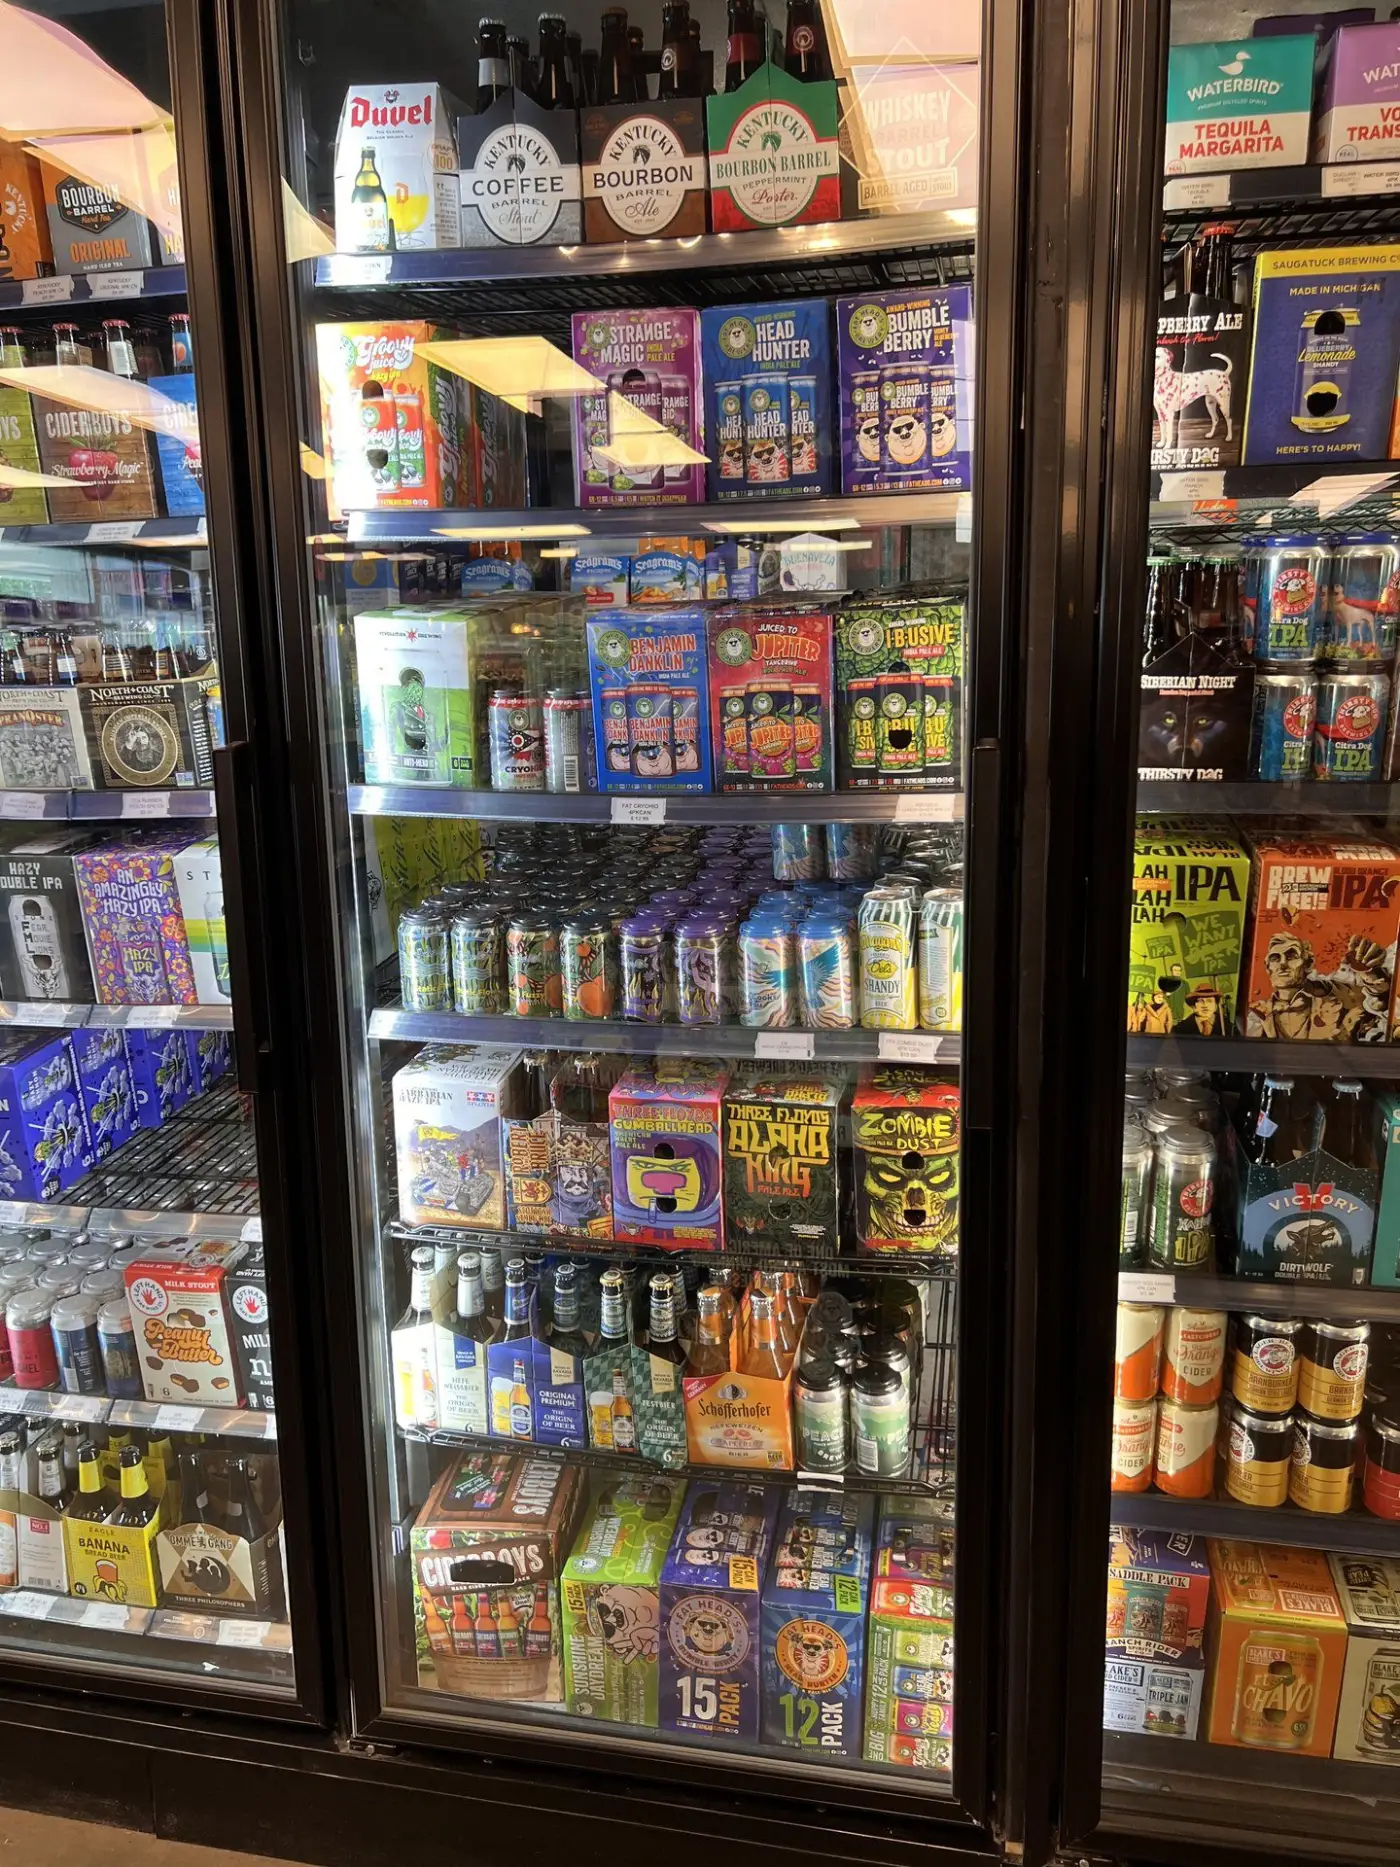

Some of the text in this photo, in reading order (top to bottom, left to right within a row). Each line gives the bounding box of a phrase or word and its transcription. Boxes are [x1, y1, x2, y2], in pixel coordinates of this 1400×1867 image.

[1187, 78, 1281, 102] WATERBIRD
[350, 96, 432, 128] Duvel
[737, 111, 808, 150] KENTUCKY
[1195, 119, 1270, 140] TEQUILA
[609, 124, 677, 161] KENTUCKY
[1179, 136, 1284, 159] MARGARITA
[484, 134, 551, 170] KENTUCKY
[716, 150, 831, 179] BOURBON BARREL
[593, 165, 693, 189] BOURBON
[742, 176, 807, 191] PEPPERMINT
[472, 176, 564, 197] COFFEE
[615, 188, 674, 200] BARREL
[61, 183, 121, 208] BOURBON
[491, 198, 549, 208] BARREL
[752, 187, 795, 205] Porter
[73, 204, 115, 216] BARREL
[624, 196, 660, 218] Ale
[499, 209, 544, 225] Stout
[70, 238, 131, 263] ORIGINAL
[1273, 258, 1335, 270] SAUGATUCK
[1338, 255, 1387, 267] BREWING
[1289, 287, 1318, 296] MADE
[1320, 286, 1330, 294] IN
[887, 306, 950, 333] BUMBLE
[609, 321, 672, 344] STRANGE
[756, 320, 795, 342] HEAD
[883, 329, 933, 353] BERRY
[1306, 344, 1350, 353] BLUEBERRY
[355, 335, 416, 371] Groovy
[600, 344, 644, 363] MAGIC
[663, 353, 675, 361] ALE
[752, 340, 810, 362] HUNTER
[1298, 348, 1357, 363] Lemonade
[1312, 361, 1339, 369] SHANDY
[896, 383, 929, 397] BUMBLE
[890, 396, 917, 408] BERRY
[45, 410, 132, 438] CIDERBOYS
[754, 410, 780, 426] HEAD
[747, 422, 786, 439] HUNTER
[1276, 443, 1361, 455] HERE'S TO HAPPY!
[51, 460, 143, 479] Strawberry Magic
[574, 556, 623, 572] Seagram's
[634, 560, 683, 573] Seagram's
[758, 624, 798, 634] JUICED TO
[1292, 616, 1309, 626] Dog
[1269, 622, 1308, 648] IPA
[629, 634, 696, 655] BENJAMIN
[751, 634, 821, 662] JUPITER
[628, 652, 684, 672] DANKLIN
[1140, 675, 1237, 689] SIBERIAN NIGHT
[89, 685, 175, 701] NORTH COAST
[629, 717, 672, 729] BENJAMIN
[634, 729, 670, 741] DANKLIN
[1335, 741, 1372, 750] Citra Dog
[1333, 750, 1374, 771] IPA
[1138, 768, 1223, 781] THIRSTY DOG
[9, 862, 41, 875] HAZY
[117, 869, 134, 883] AN
[1269, 865, 1332, 887] BREW
[43, 877, 63, 890] IPA
[1174, 864, 1241, 902] IPA
[1330, 874, 1390, 908] IPA
[103, 898, 161, 917] HAZY IPA
[1192, 913, 1219, 930] WE
[1184, 925, 1236, 948] WANT
[123, 948, 157, 962] HAZY
[1151, 946, 1172, 957] IPA
[133, 961, 153, 973] IPA
[1203, 960, 1227, 973] IPA
[865, 982, 900, 994] SHANDY
[612, 1105, 713, 1123] THREE FLOYDS
[726, 1103, 829, 1125] THREE FLOYDS
[613, 1119, 714, 1134] GUMBALLHEAD
[858, 1112, 953, 1138] ZOMBIE
[728, 1120, 830, 1158] ALPHA
[897, 1137, 941, 1151] DUST
[757, 1184, 799, 1197] PALE ALE
[1268, 1193, 1359, 1214] VICTORY
[1279, 1262, 1331, 1272] DIRTWOLF
[134, 1282, 163, 1298] LEFT HAND
[144, 1318, 210, 1350] Peanut
[158, 1340, 223, 1365] Butter
[1183, 1367, 1212, 1377] CIDER
[451, 1377, 470, 1385] HEFE
[539, 1390, 575, 1400] ORIGINAL
[540, 1397, 575, 1408] PREMIUM
[447, 1399, 477, 1408] ORIGIN
[699, 1398, 771, 1418] Schöfferhofer
[542, 1420, 575, 1430] OF BEER
[544, 1414, 573, 1424] ORIGIN
[710, 1422, 763, 1432] HEFEWEIZEN
[647, 1424, 676, 1433] ORIGIN
[657, 1432, 679, 1440] BEER
[1118, 1459, 1145, 1468] CIDER
[88, 1527, 115, 1536] EAGLE
[78, 1537, 130, 1555] BANANA
[84, 1550, 126, 1560] BREAD BEER
[1109, 1568, 1189, 1588] SADDLE PACK
[175, 1595, 245, 1608] THREE PHILOSOPHERS
[566, 1586, 584, 1613] 15 CAN
[782, 1624, 842, 1650] FAT HEAD'S
[1145, 1642, 1178, 1656] RIDER
[1249, 1649, 1281, 1659] BLAKE'S
[570, 1634, 591, 1696] SUNSHINE
[587, 1636, 606, 1700] DAYDREAM
[676, 1677, 718, 1720] 15
[718, 1682, 740, 1726] PACK
[1149, 1690, 1173, 1703] TRIPLE
[1243, 1683, 1313, 1713] CHAVO
[779, 1694, 822, 1746] 12
[821, 1701, 844, 1747] PACK
[870, 1730, 884, 1750] BIG
